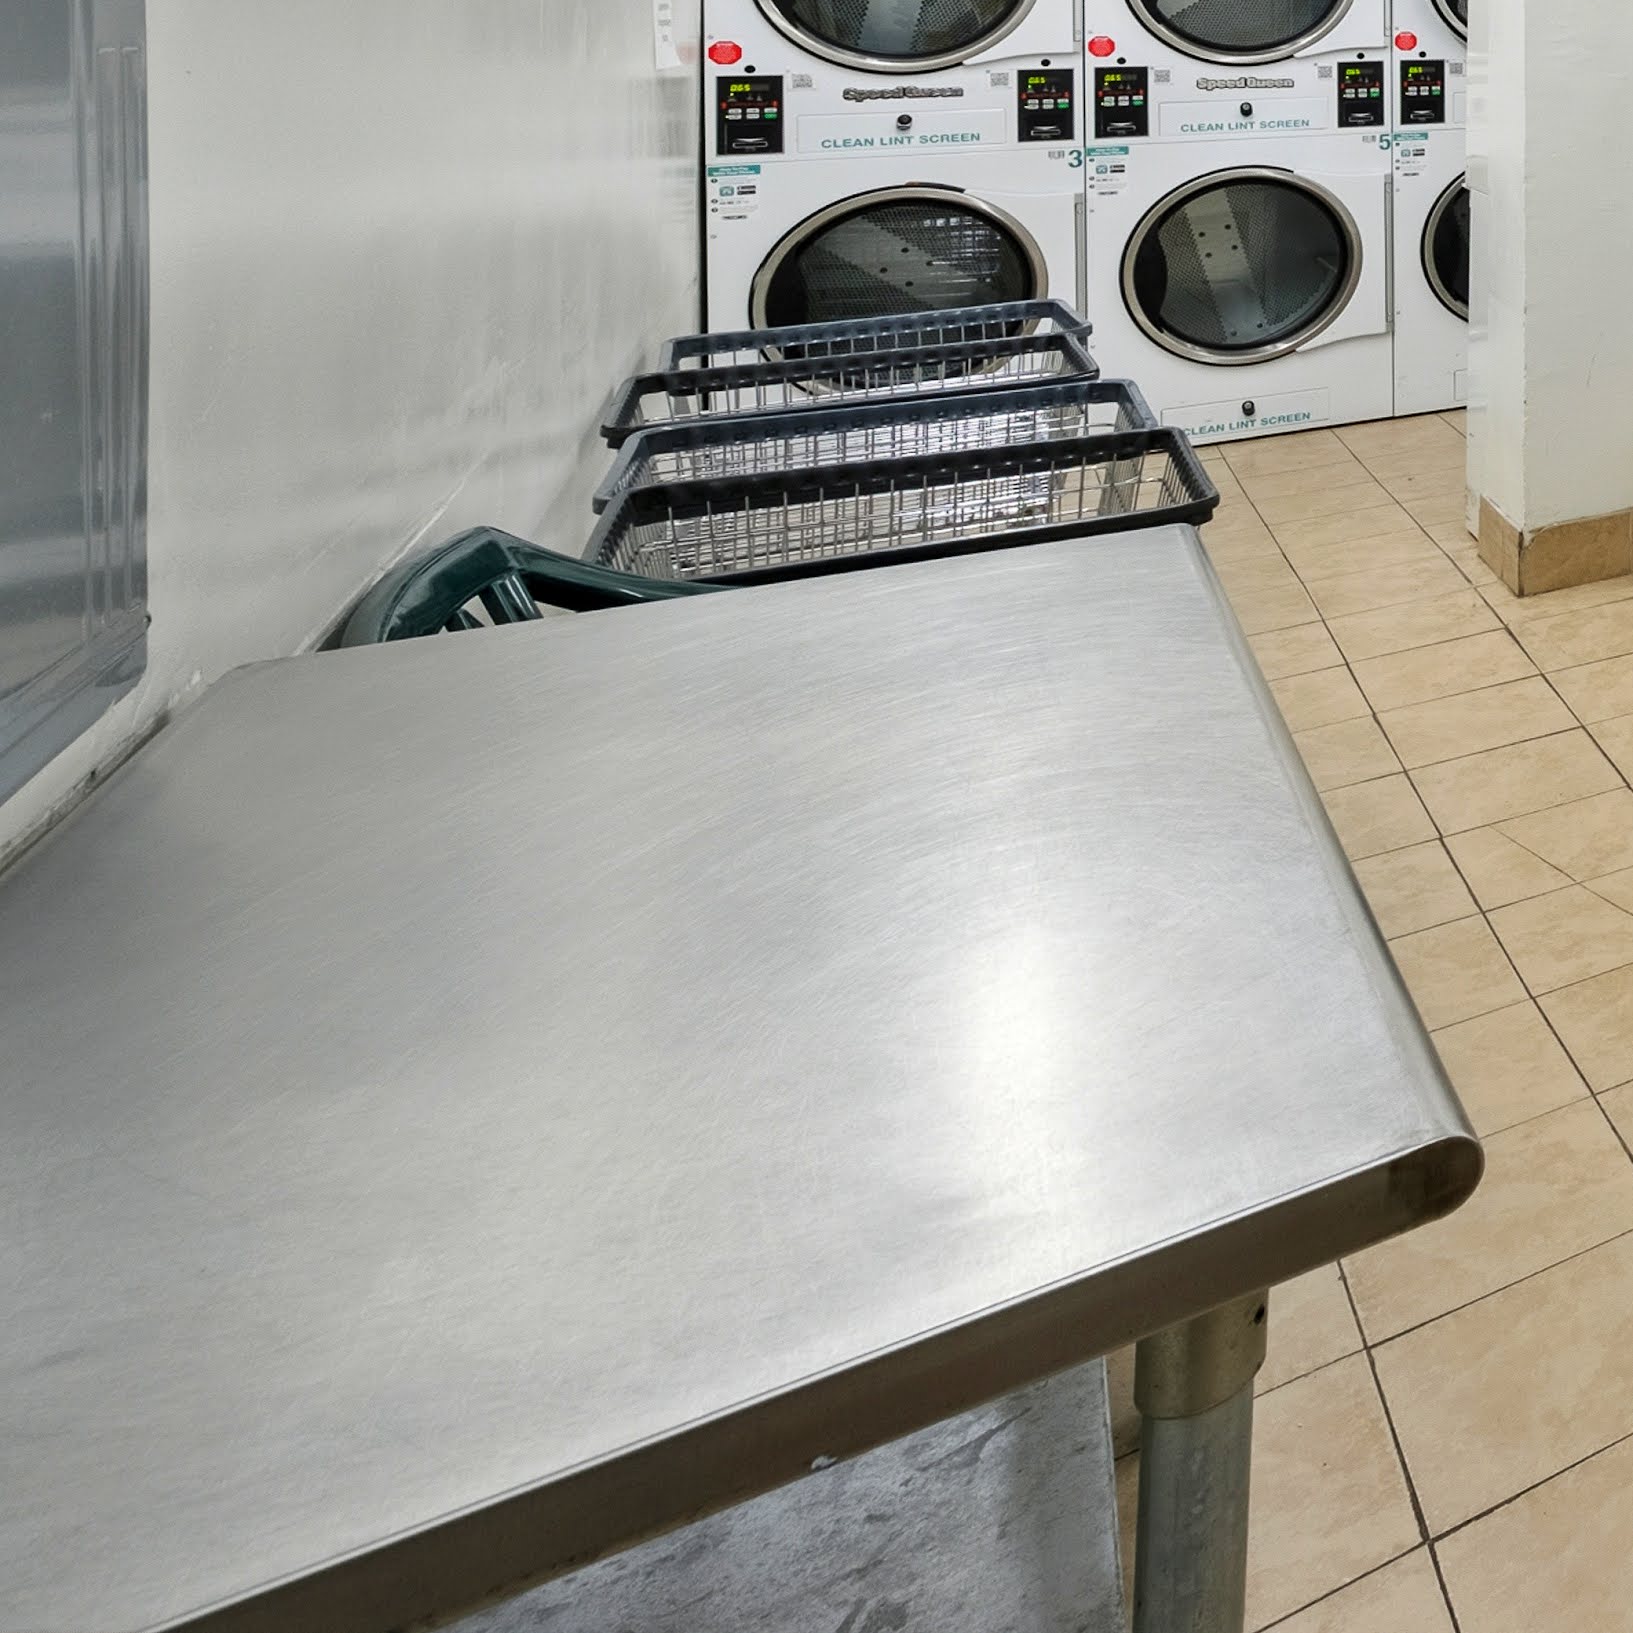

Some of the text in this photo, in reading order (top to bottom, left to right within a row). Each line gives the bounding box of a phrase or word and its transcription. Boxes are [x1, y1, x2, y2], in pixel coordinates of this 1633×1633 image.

[1196, 77, 1294, 91] Speed Queen
[1180, 118, 1310, 133] CLEAN LINT SCREEN
[821, 132, 980, 149] CLEAN LINT SCREEN
[1379, 133, 1391, 151] 5
[1068, 149, 1083, 168] 3
[1183, 411, 1311, 437] CLEAN LINT SCREEN
